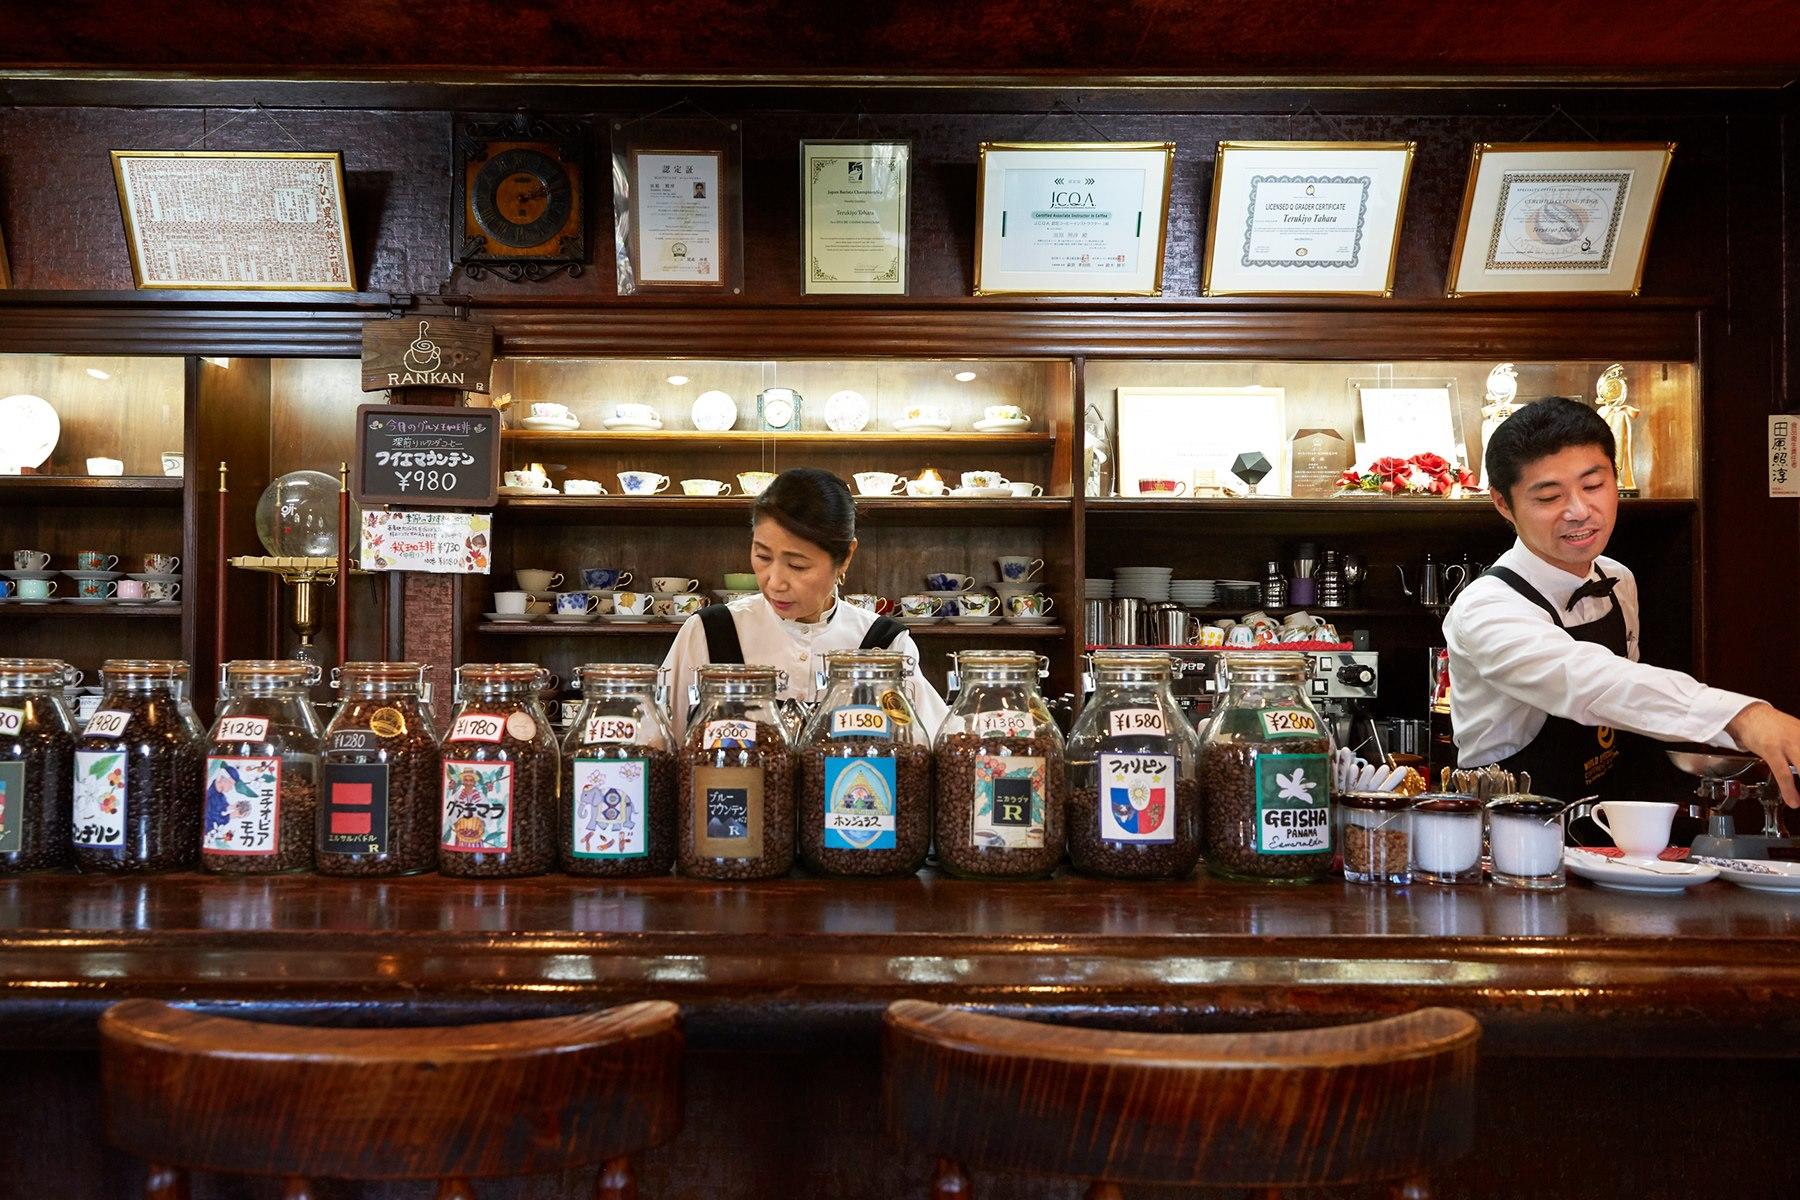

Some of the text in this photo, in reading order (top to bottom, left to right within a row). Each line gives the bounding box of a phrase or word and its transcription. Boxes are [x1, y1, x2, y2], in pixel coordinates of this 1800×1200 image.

[1265, 203, 1289, 211] LICENSED
[1294, 203, 1315, 211] GRADER
[1315, 203, 1346, 211] CERTIFICATE
[1283, 213, 1338, 225] Terukiyo Tahara
[387, 372, 465, 386] RANKAN
[394, 470, 457, 492] ¥980
[456, 719, 498, 736] ¥1780
[1265, 712, 1315, 731] ¥2800
[221, 721, 264, 738] ¥1280
[589, 719, 635, 741] ¥1580
[334, 733, 366, 748] ¥1280
[1110, 758, 1167, 774] フィリピン
[709, 791, 735, 802] ブルー
[709, 803, 748, 816] マウンテン
[1002, 804, 1023, 821] R
[834, 815, 882, 828] ホンジュラス
[1265, 809, 1327, 828] GEISHA
[240, 821, 255, 847] モカ
[729, 825, 741, 836] R
[1286, 828, 1318, 839] PANAMA
[369, 844, 380, 853] R
[580, 831, 632, 853] インド
